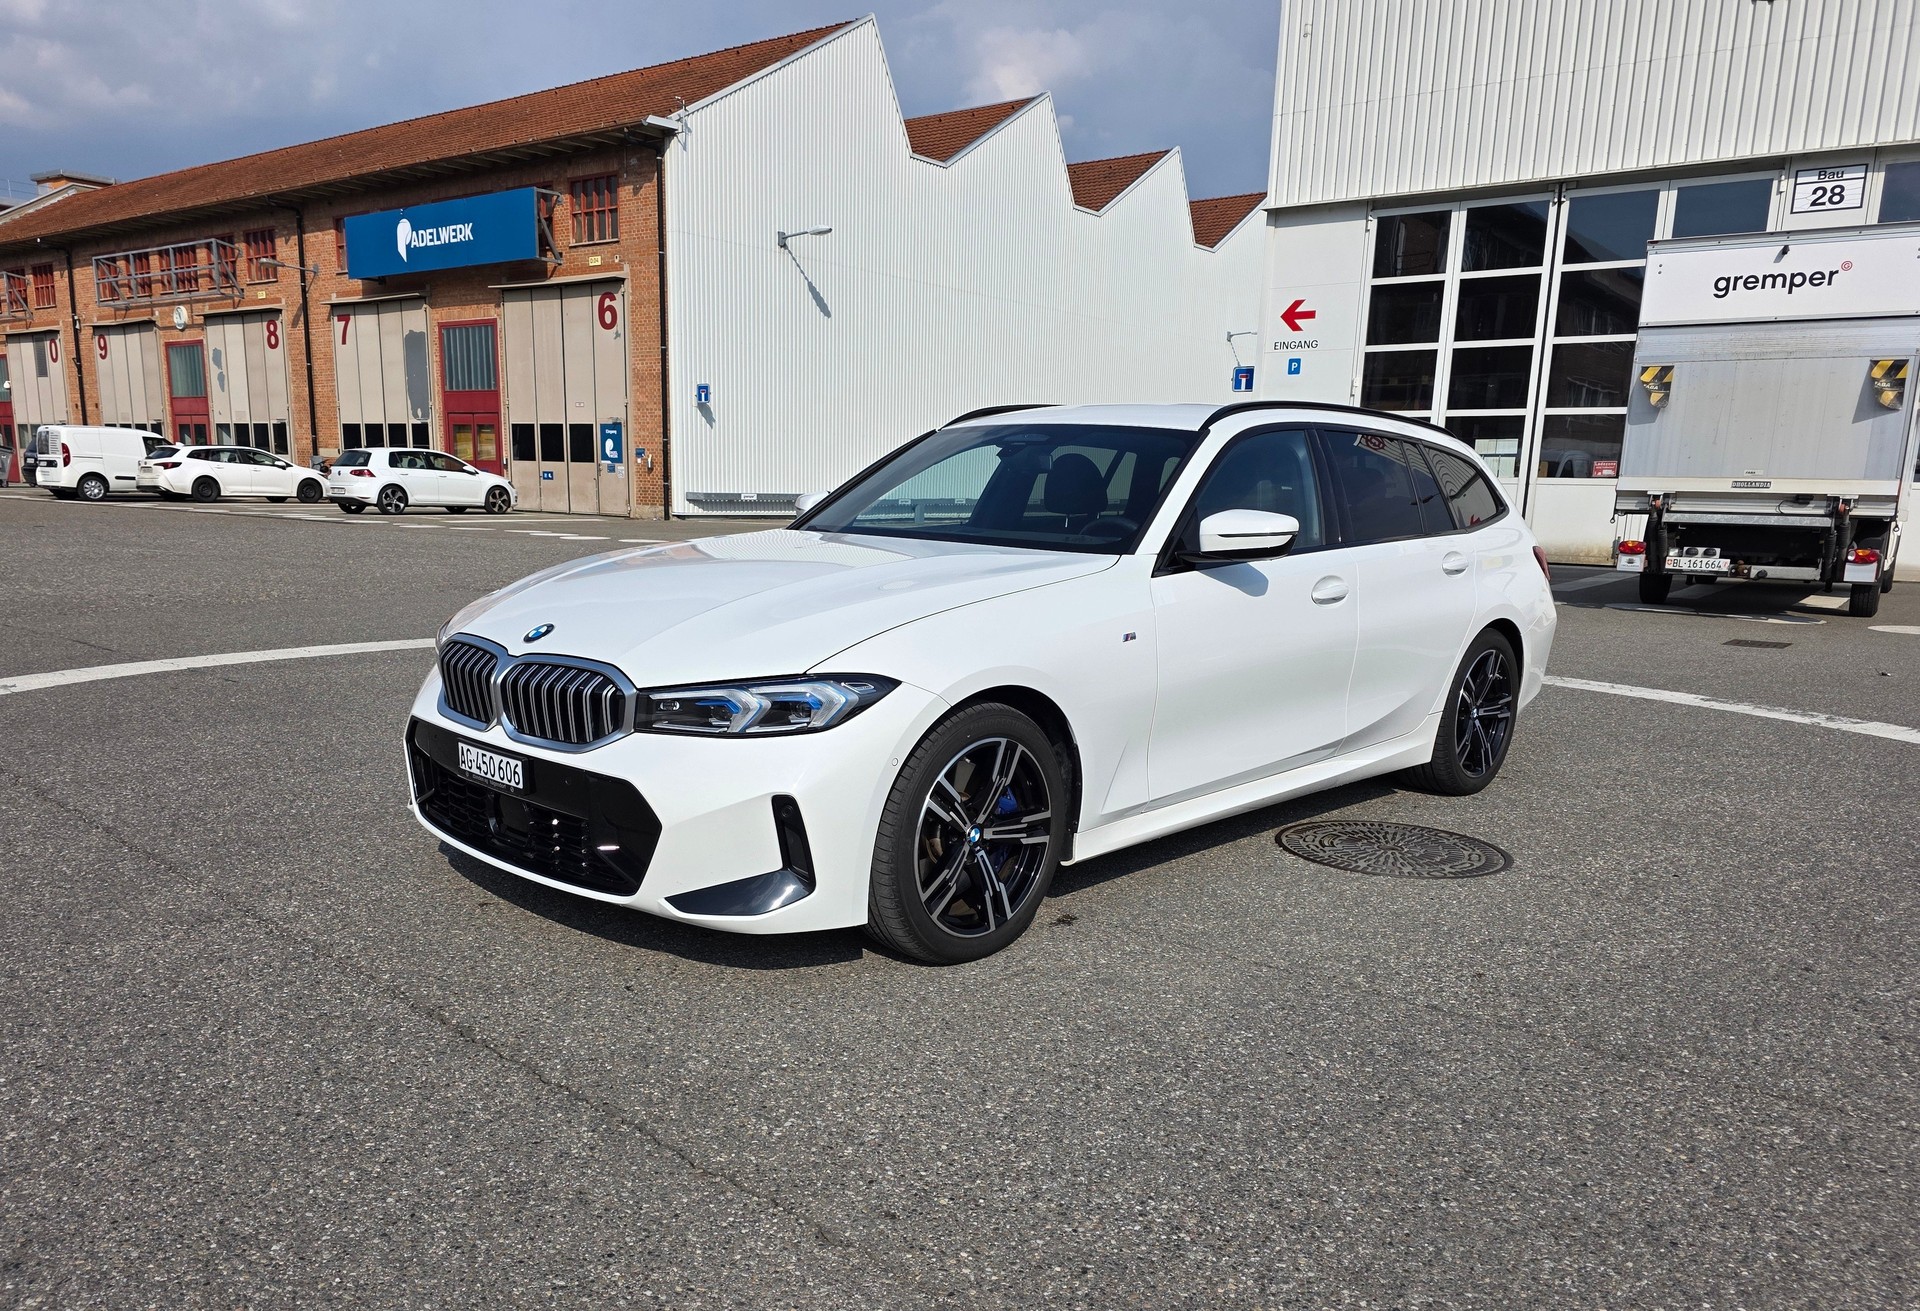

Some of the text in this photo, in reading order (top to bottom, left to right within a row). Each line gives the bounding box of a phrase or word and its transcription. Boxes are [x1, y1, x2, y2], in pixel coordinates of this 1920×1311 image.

[1818, 170, 1845, 180] Bau
[1810, 185, 1845, 207] 28
[1713, 270, 1839, 299] gremper
[598, 291, 618, 330] 6
[266, 319, 279, 349] 8
[337, 314, 351, 345] 7
[49, 338, 59, 363] 0
[98, 334, 108, 360] 9
[1273, 340, 1319, 350] EINGANG
